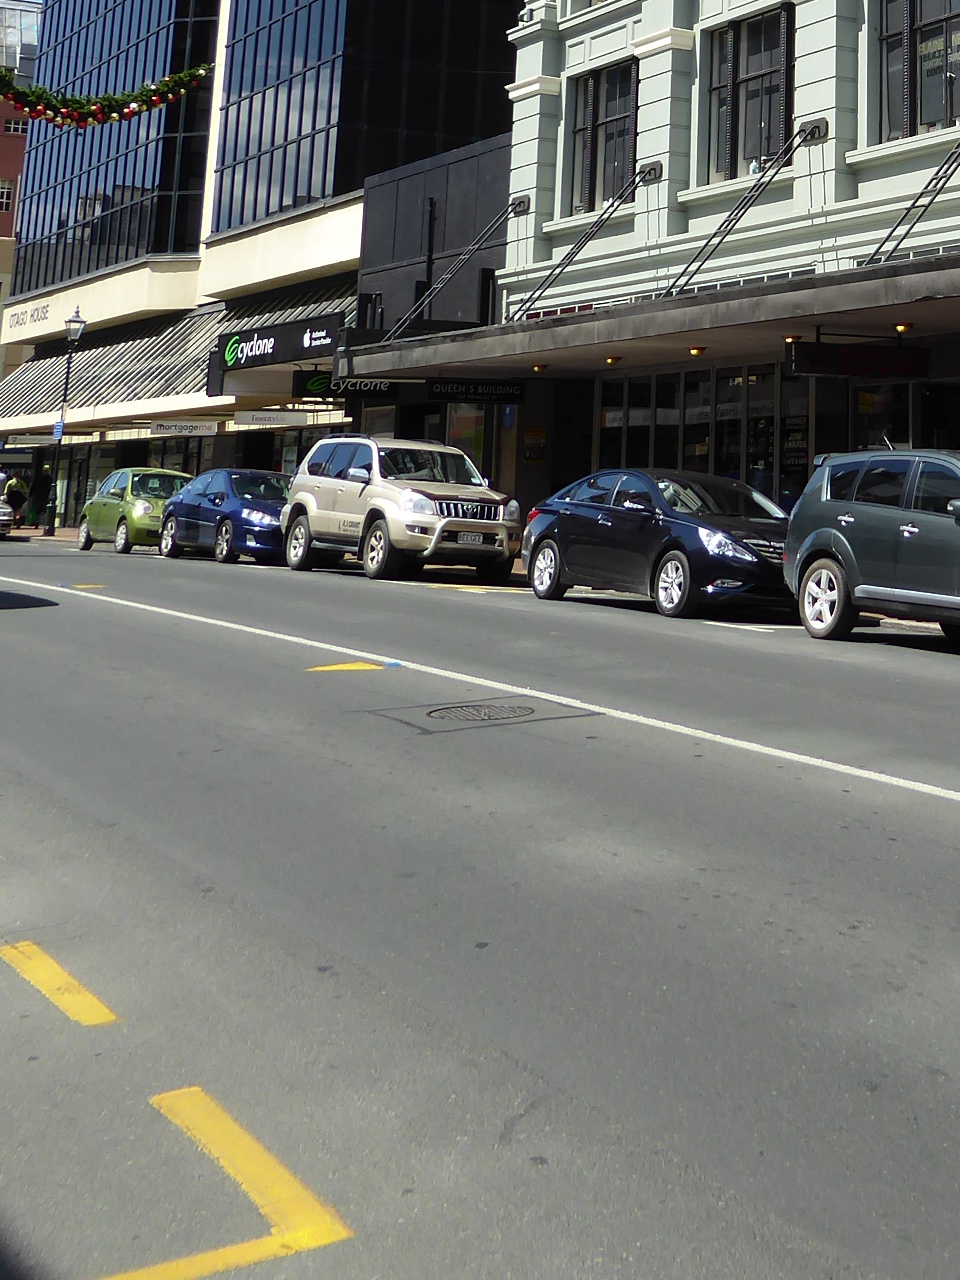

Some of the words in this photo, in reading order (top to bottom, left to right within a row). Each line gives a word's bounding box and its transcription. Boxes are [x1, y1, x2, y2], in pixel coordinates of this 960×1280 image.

[9, 310, 28, 328] OTAGO
[30, 304, 50, 324] HOUSE
[237, 333, 275, 363] cyclone
[330, 378, 390, 394] cyclone
[433, 384, 475, 393] QUEEN'S
[477, 385, 521, 395] BUILDING
